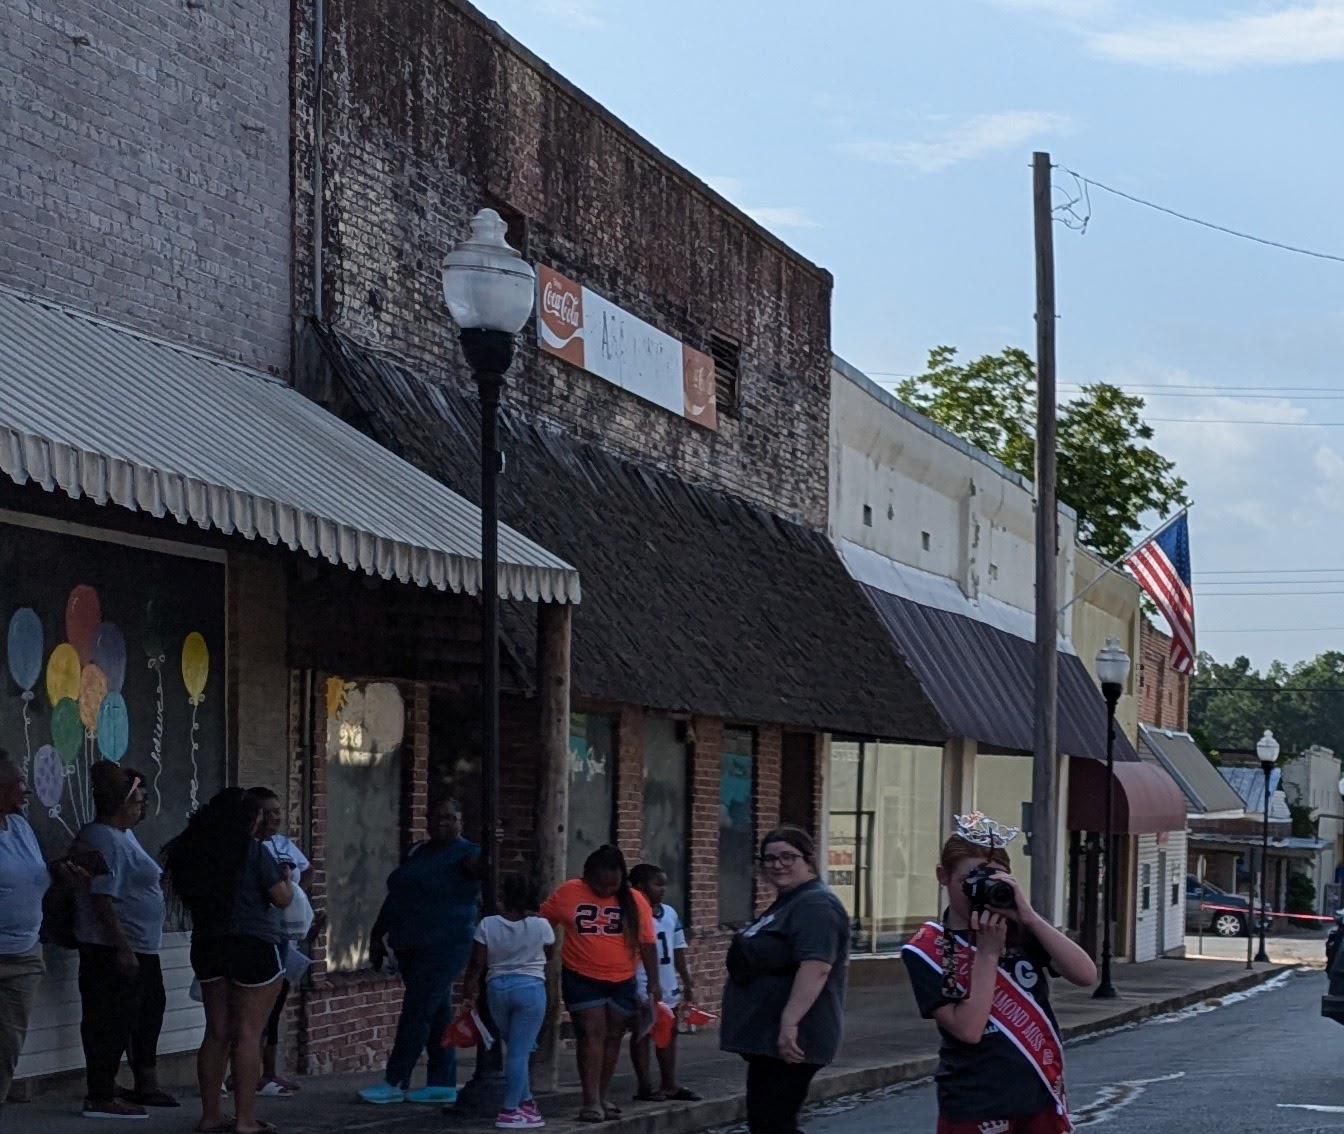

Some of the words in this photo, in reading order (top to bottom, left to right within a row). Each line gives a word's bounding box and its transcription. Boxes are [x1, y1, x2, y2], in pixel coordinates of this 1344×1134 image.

[575, 904, 624, 935] 23
[993, 988, 1030, 1028] AMOND
[1021, 1021, 1046, 1052] MISS
